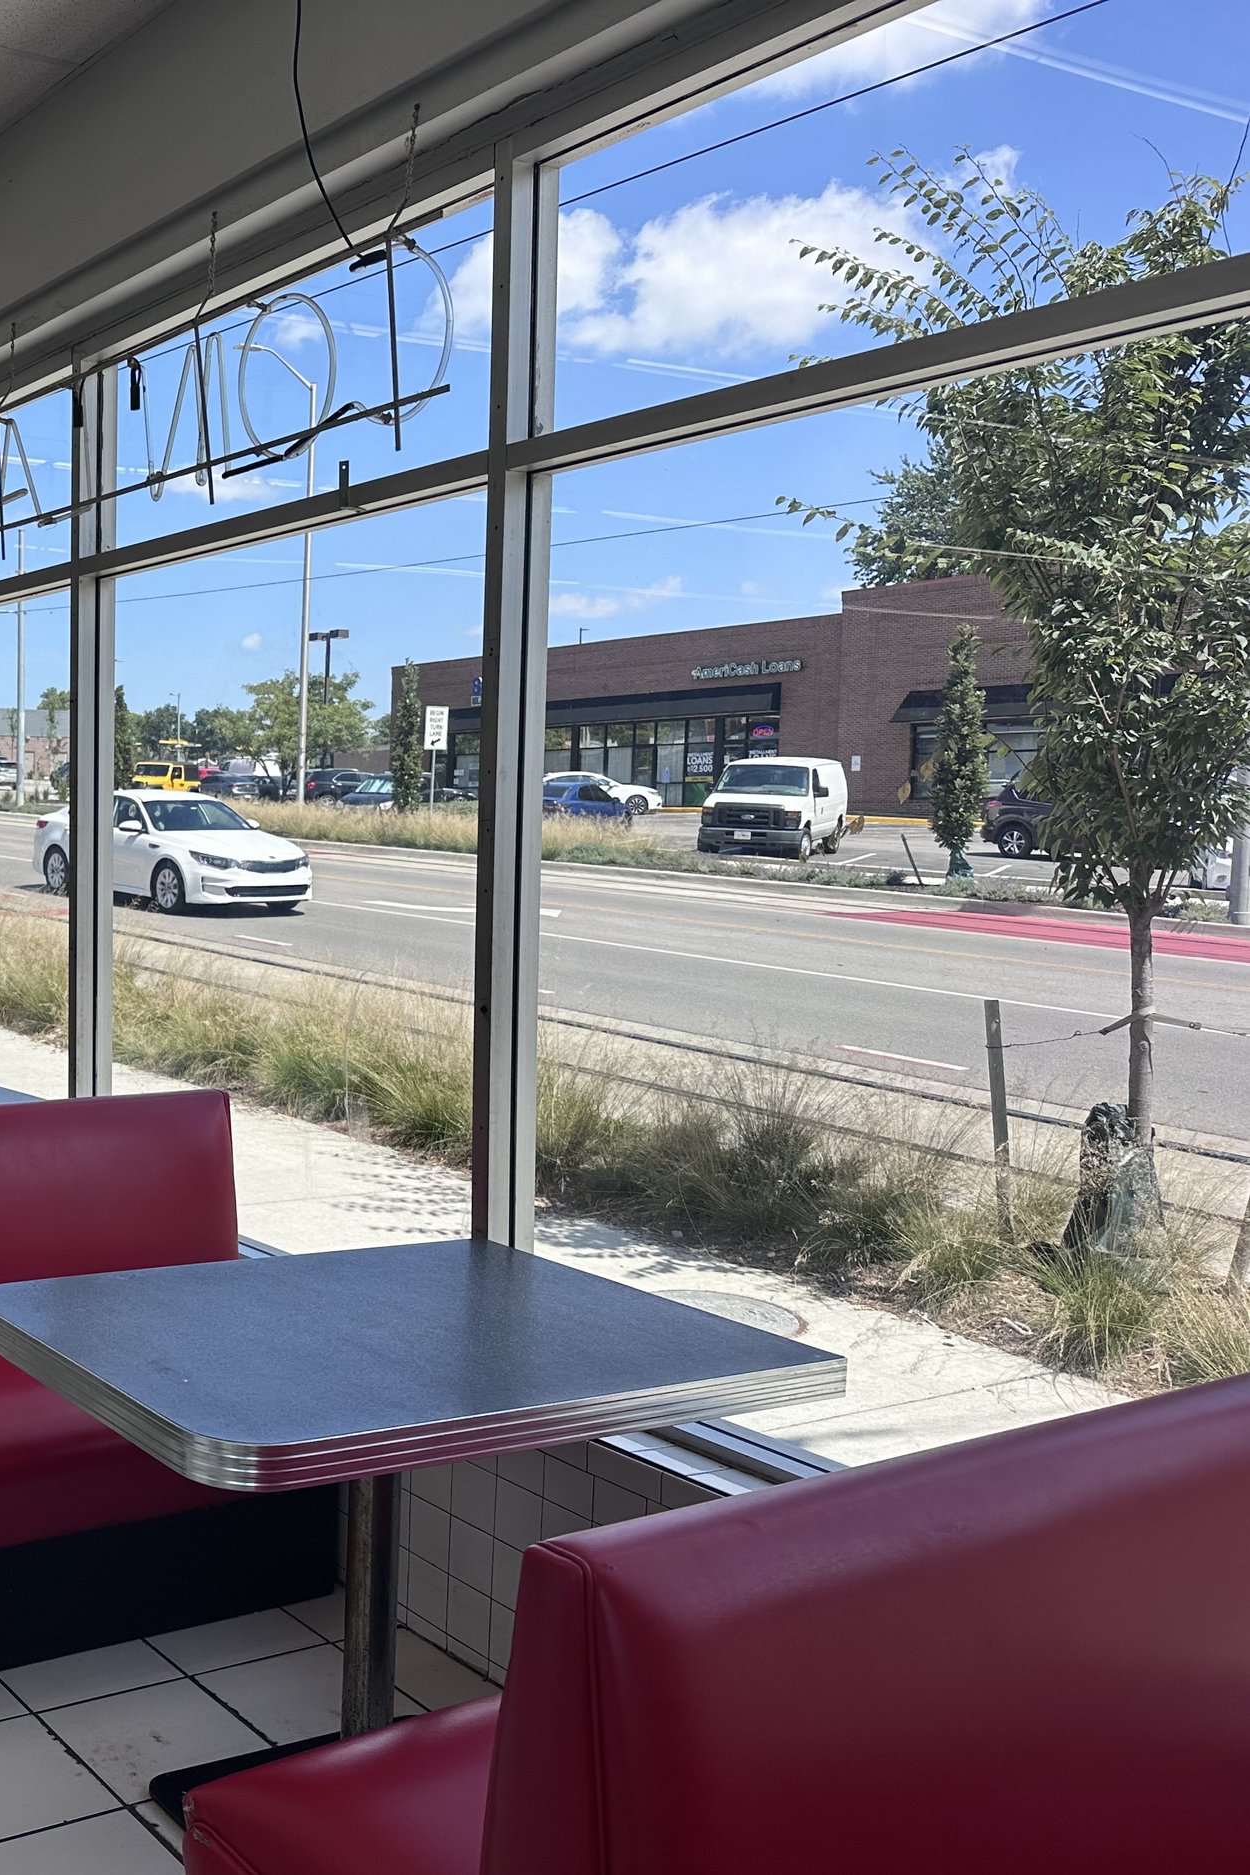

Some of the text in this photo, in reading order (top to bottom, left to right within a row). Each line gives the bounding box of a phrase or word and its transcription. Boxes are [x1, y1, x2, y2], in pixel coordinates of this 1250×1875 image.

[693, 660, 801, 679] AmeriCash Loans
[753, 727, 773, 737] OPEN
[686, 757, 713, 765] LOANS
